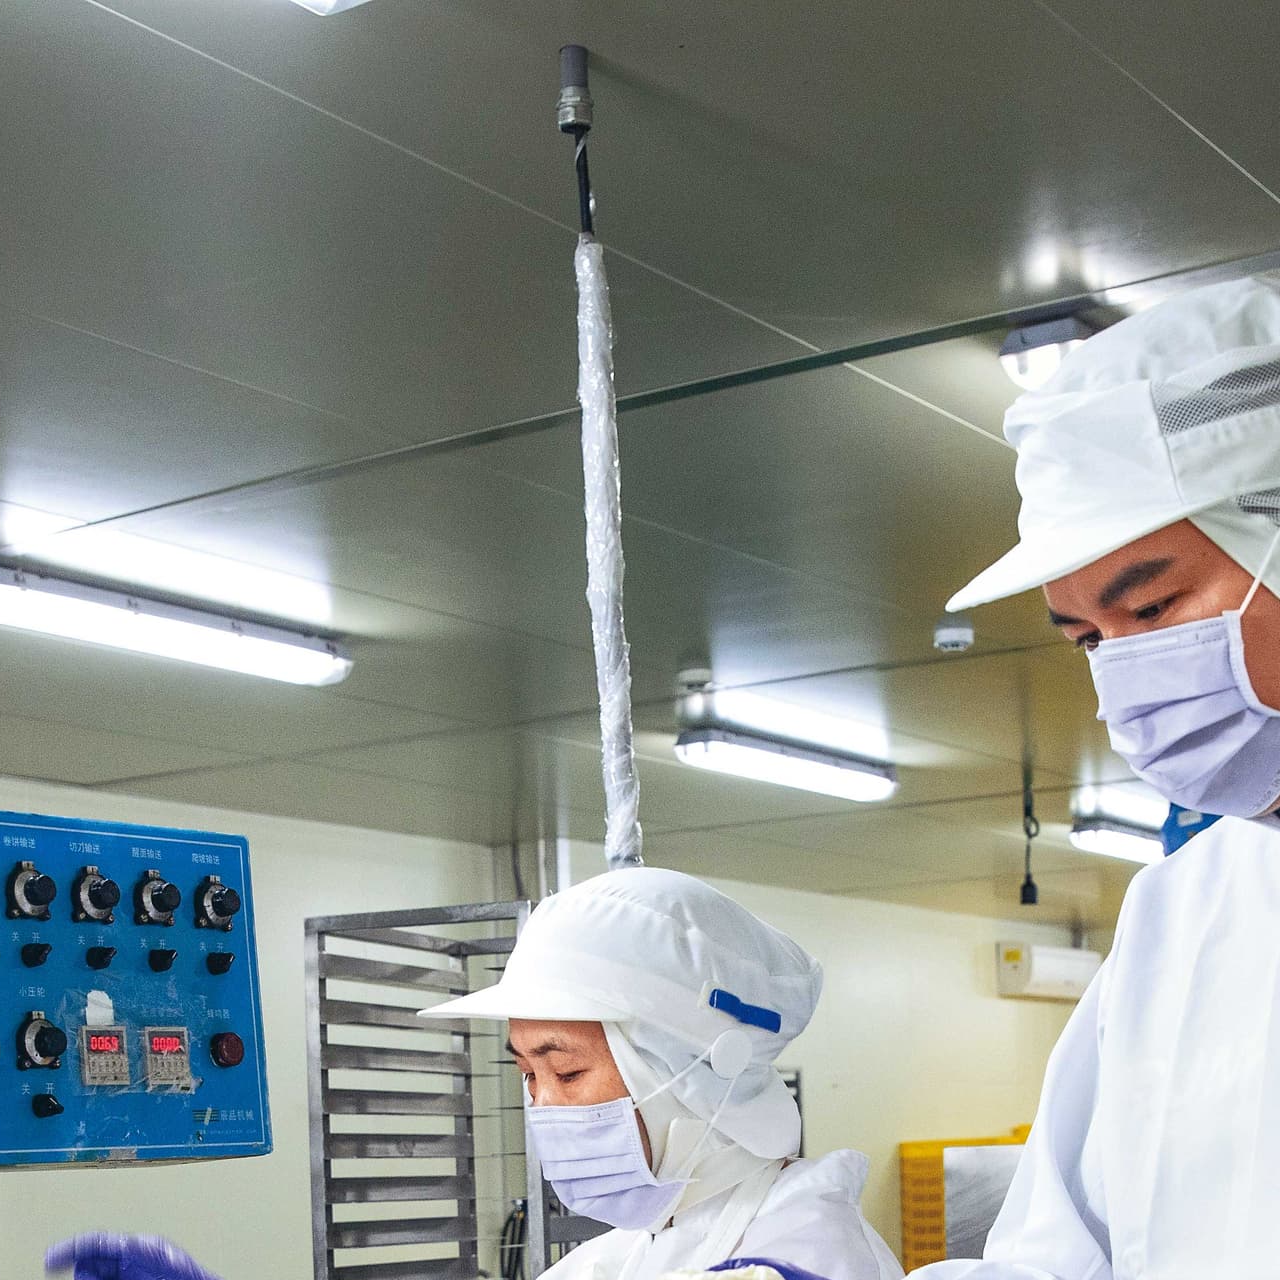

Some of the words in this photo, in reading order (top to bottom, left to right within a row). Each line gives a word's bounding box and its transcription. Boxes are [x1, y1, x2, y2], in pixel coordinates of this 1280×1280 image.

[31, 932, 40, 943] 开
[96, 936, 105, 946] 开
[158, 938, 167, 949] 开
[216, 942, 224, 953] 开
[22, 1083, 31, 1095] 关
[45, 1082, 55, 1094] 开
